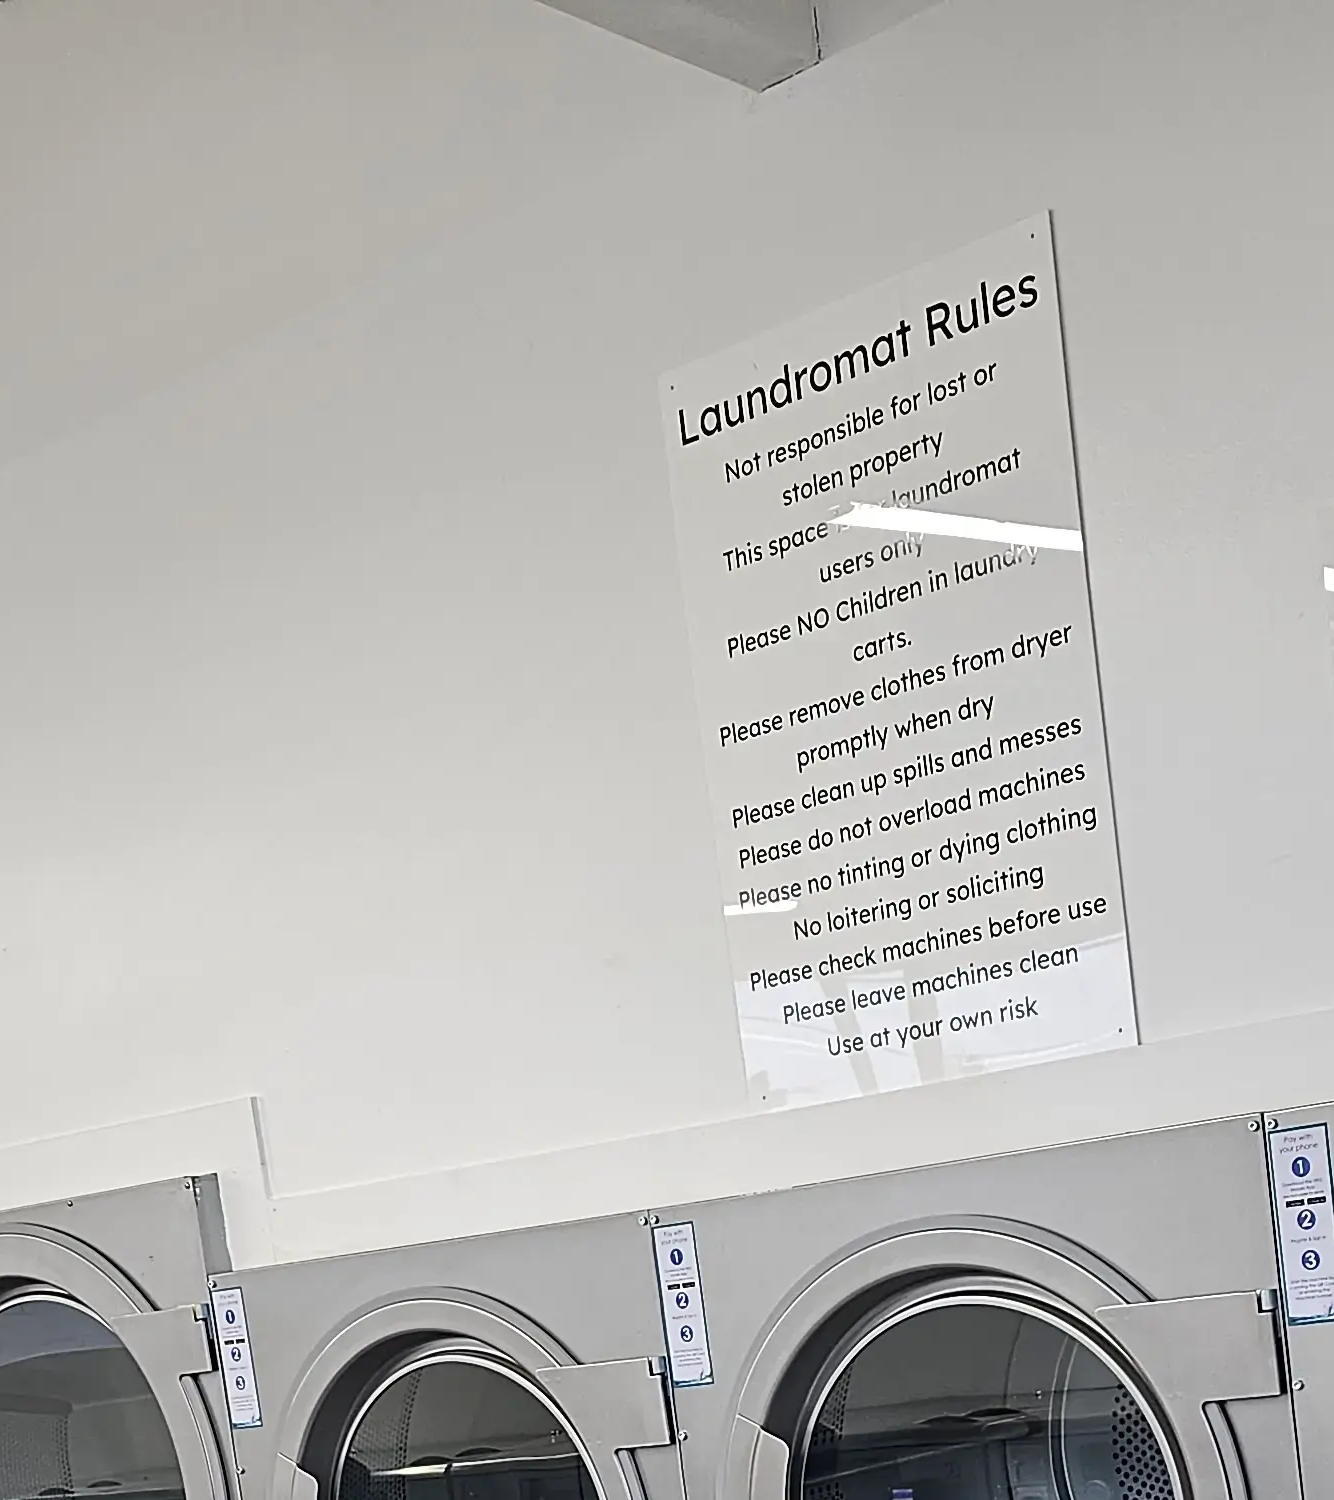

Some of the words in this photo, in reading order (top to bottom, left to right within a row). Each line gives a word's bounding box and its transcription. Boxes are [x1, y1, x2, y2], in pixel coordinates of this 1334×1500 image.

[679, 320, 911, 446] Laundromat
[926, 275, 1037, 346] Rules
[725, 452, 761, 483] Not
[768, 407, 883, 467] responsible
[891, 393, 920, 419] for
[928, 372, 966, 405] lost
[974, 363, 996, 386] or
[783, 471, 843, 506] stolen
[850, 432, 942, 488] property
[723, 542, 762, 571] This
[769, 522, 828, 559] space
[892, 448, 1020, 508] laundromat
[728, 625, 791, 658] Please
[798, 608, 829, 635] NO
[837, 581, 922, 621] Children
[928, 570, 948, 592] in
[954, 543, 1038, 584] laundry
[820, 552, 874, 582] users
[720, 715, 782, 747] Please
[789, 691, 864, 726] remove
[871, 666, 945, 701] clothes
[952, 648, 1004, 677] from
[1012, 625, 1071, 658] dryer
[854, 632, 911, 661] carts.
[733, 799, 795, 828] Please
[802, 782, 854, 809] clean
[861, 773, 886, 796] up
[893, 753, 944, 787] spills
[952, 737, 992, 767] and
[1000, 719, 1081, 755] messes
[797, 725, 888, 773] promptly
[894, 710, 951, 738] when
[958, 696, 993, 720] dry
[739, 840, 801, 869] Please
[809, 829, 833, 850] do
[840, 817, 872, 843] not
[879, 788, 971, 831] overload
[979, 764, 1085, 806] machines
[739, 883, 801, 909] Please
[808, 875, 831, 894] no
[838, 856, 904, 886] tinting
[912, 849, 932, 867] or
[940, 832, 999, 863] dying
[1007, 807, 1096, 843] clothing
[750, 965, 812, 991] Please
[819, 946, 877, 976] check
[883, 926, 982, 962] machines
[989, 908, 1060, 938] before
[1068, 898, 1106, 920] use
[794, 919, 821, 940] No
[827, 898, 911, 932] loitering
[919, 891, 939, 910] or
[947, 867, 1043, 903] soliciting
[783, 998, 845, 1024] Please
[852, 986, 905, 1010] leave
[912, 962, 1012, 997] machines
[1020, 948, 1078, 973] clean
[828, 1036, 863, 1056] Use
[870, 1028, 890, 1048] at
[896, 1020, 943, 1048] your
[950, 1010, 992, 1031] own
[1000, 996, 1038, 1022] risk
